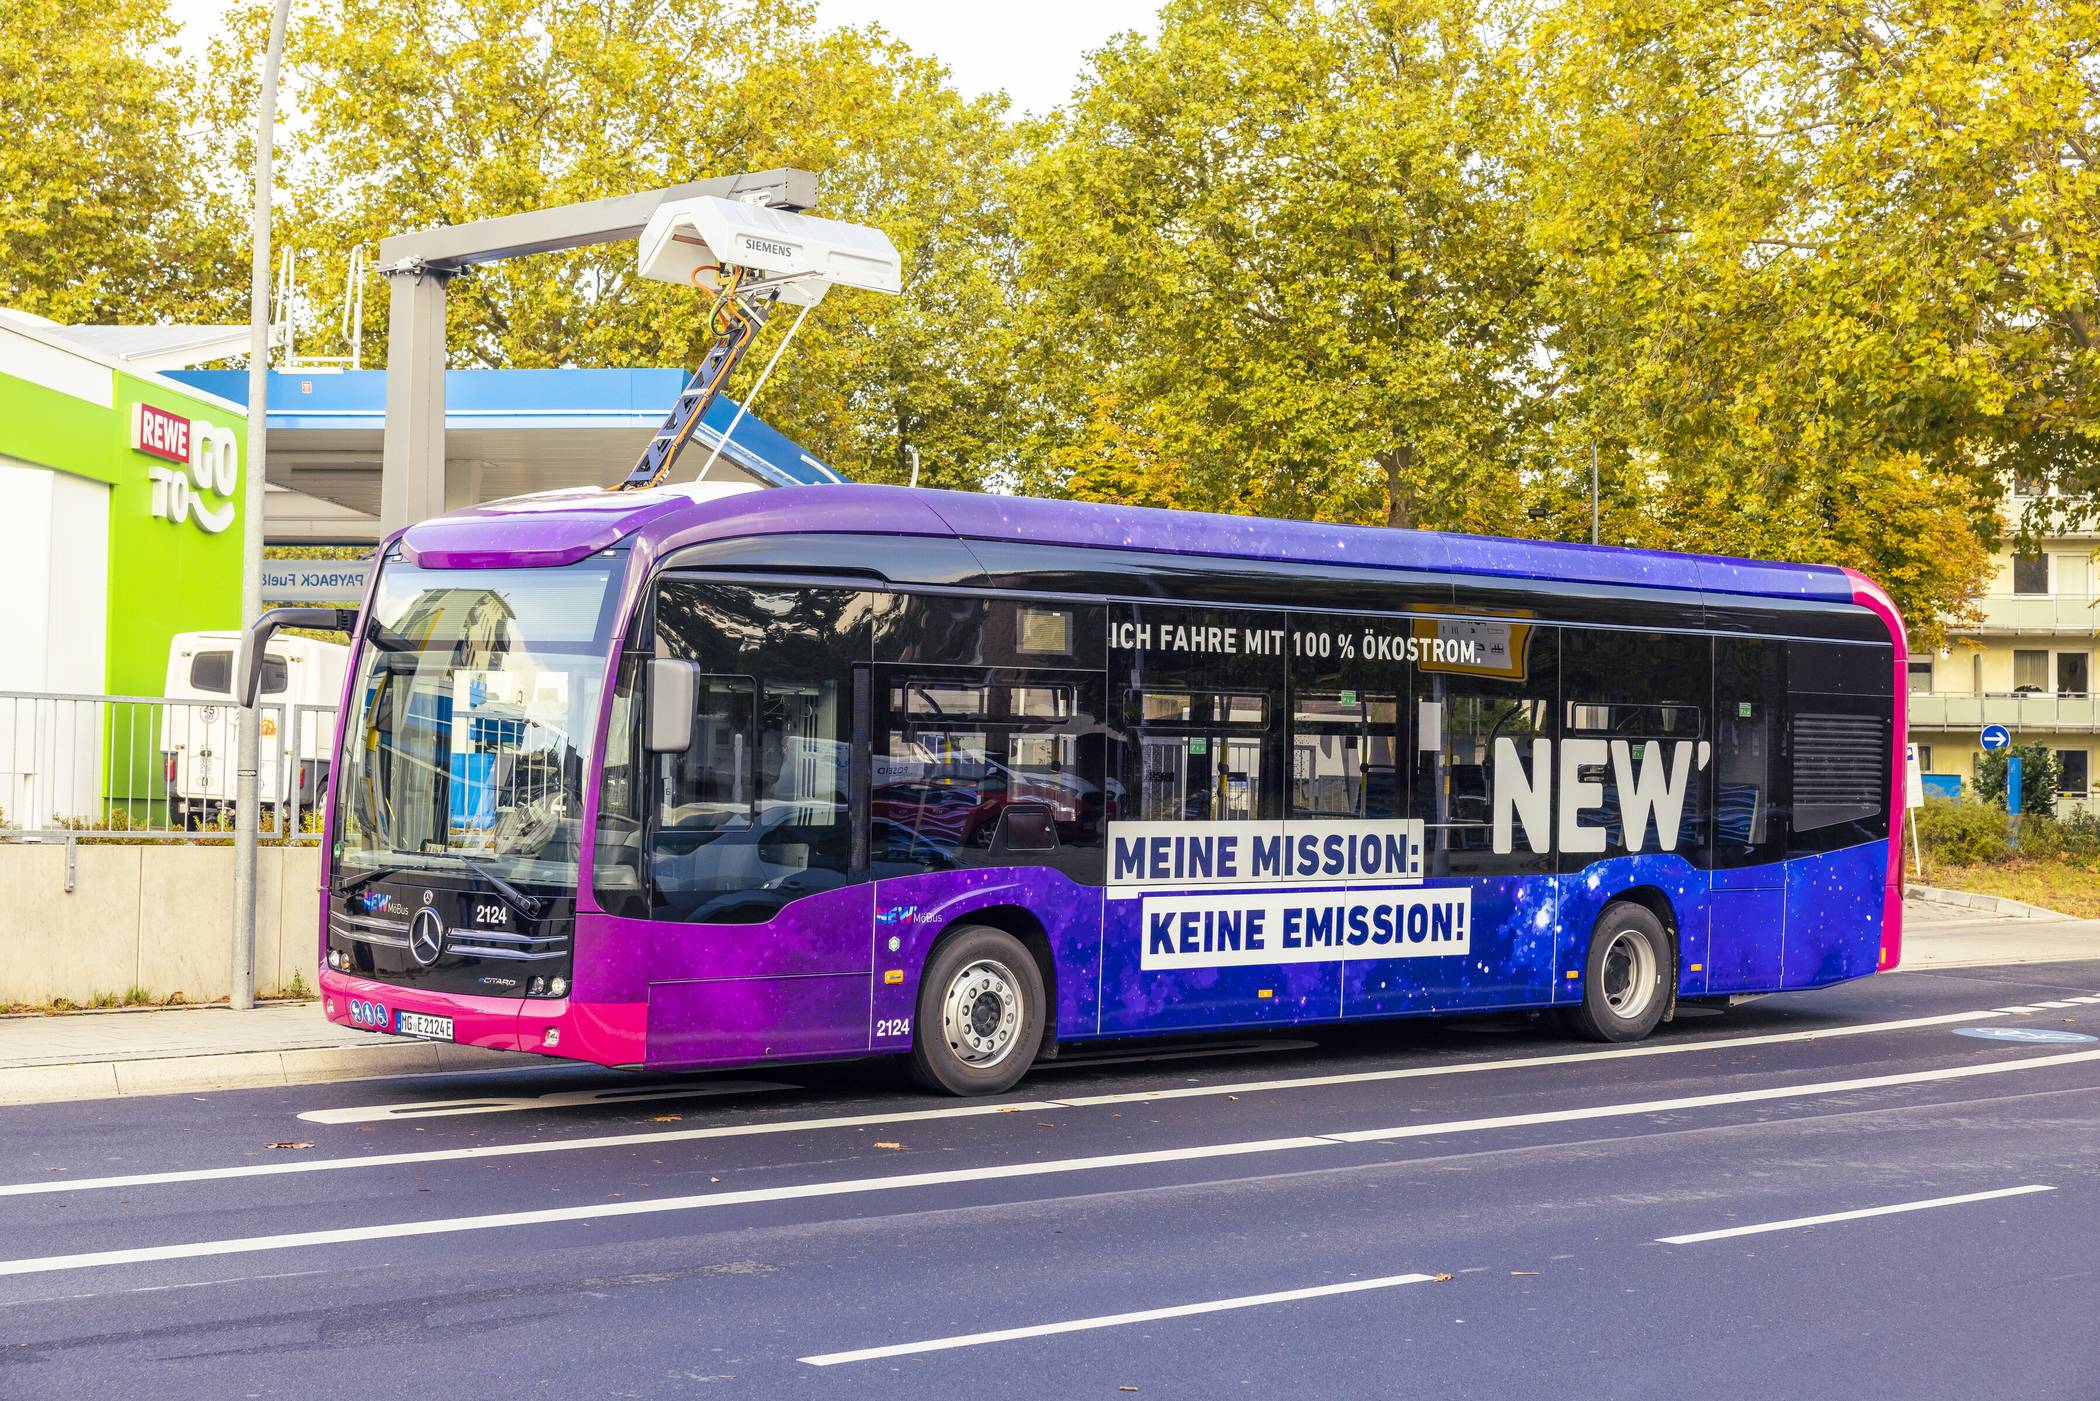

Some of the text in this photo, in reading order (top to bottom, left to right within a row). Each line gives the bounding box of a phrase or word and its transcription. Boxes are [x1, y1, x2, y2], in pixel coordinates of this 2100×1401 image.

[745, 239, 792, 257] SIEMENS
[143, 410, 238, 523] REWE TO GO
[1111, 622, 1151, 650] ICH
[1160, 624, 1237, 654] FAHRE
[1245, 629, 1285, 656] MIT
[1293, 631, 1331, 658] 100
[1337, 633, 1355, 660] %
[1362, 628, 1481, 664] ÖKOSTROM.
[1114, 833, 1419, 880] MEINE MISSION:
[476, 904, 508, 924] 2124
[1149, 902, 1465, 956] KEINE EMISSION!
[877, 1018, 910, 1037] 2124
